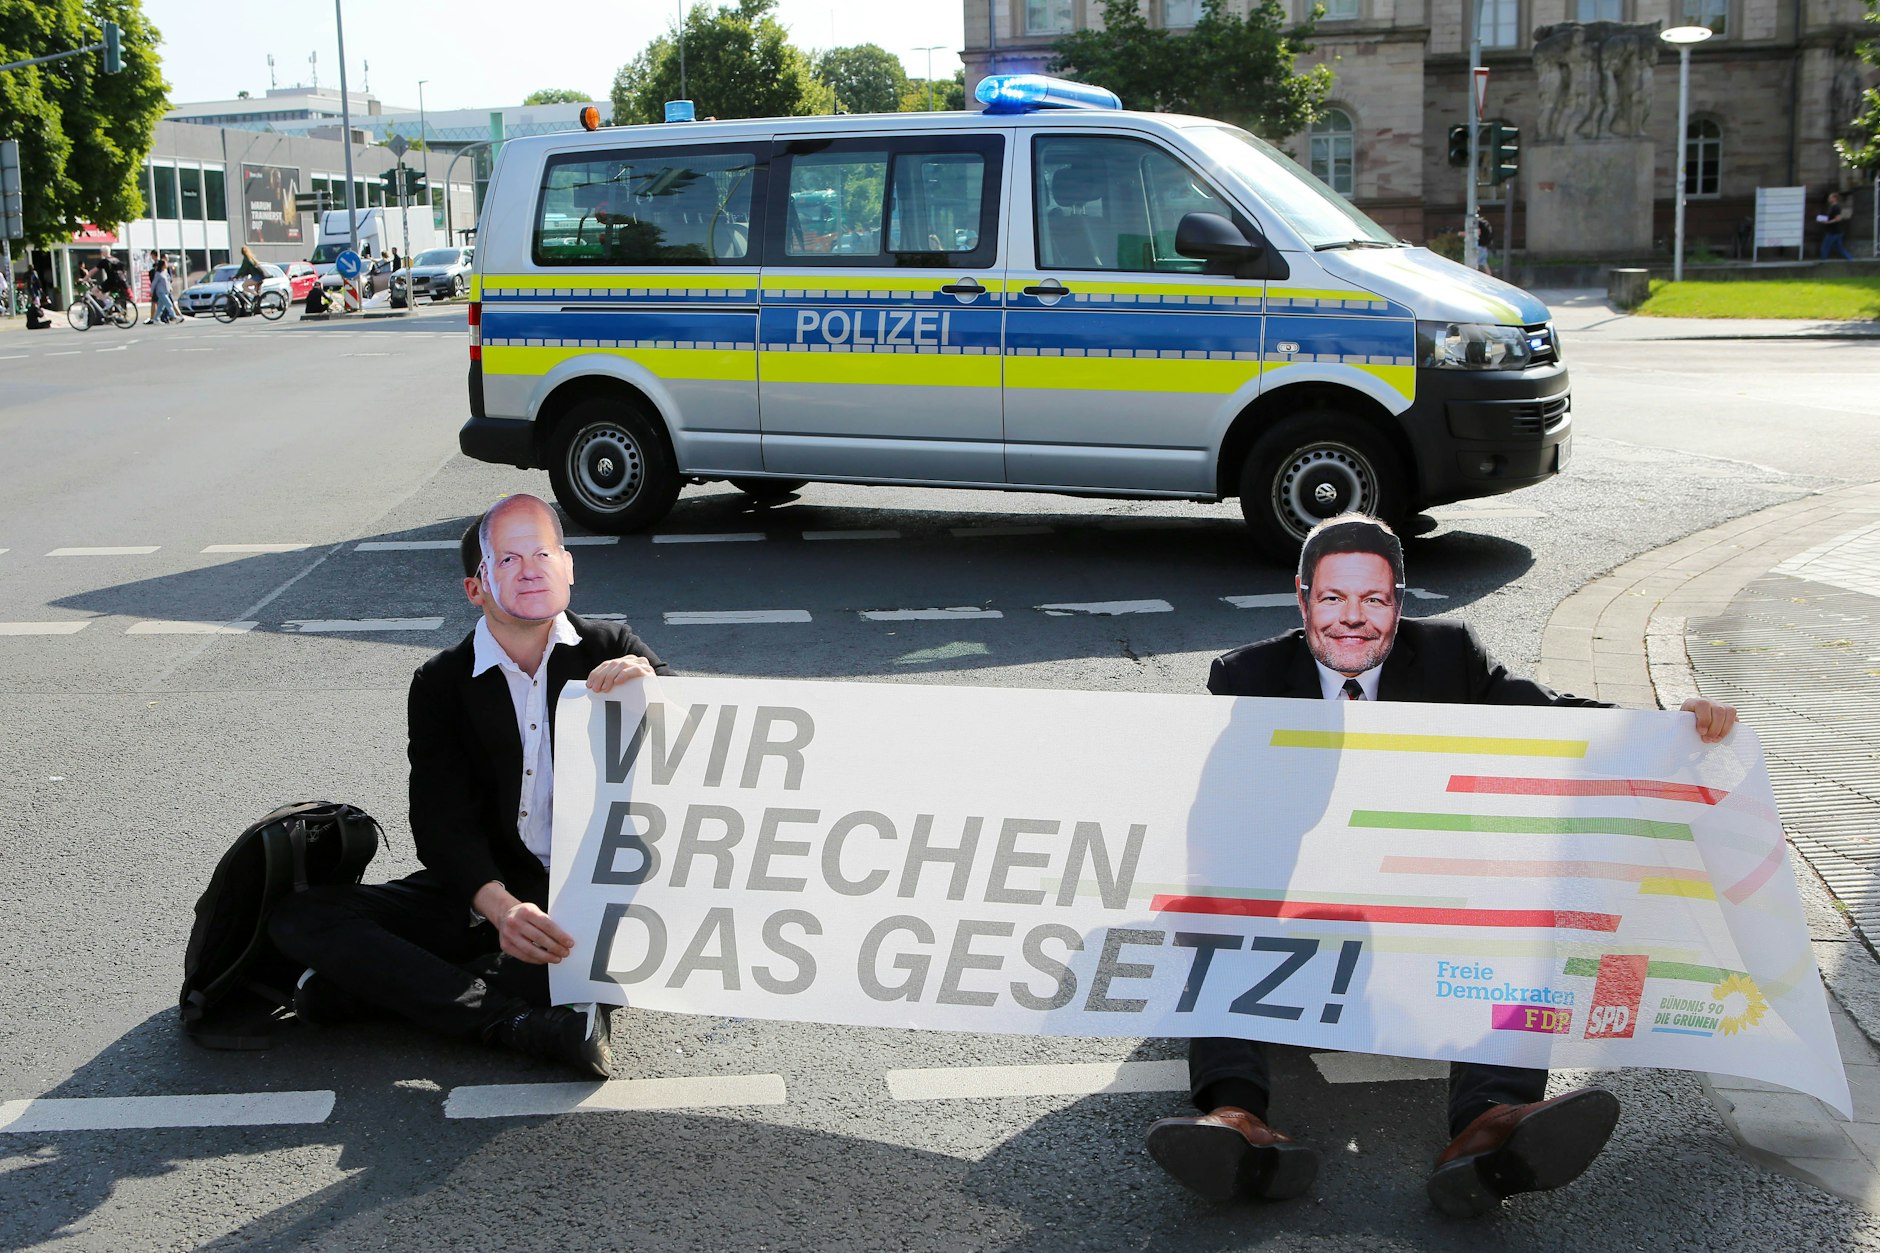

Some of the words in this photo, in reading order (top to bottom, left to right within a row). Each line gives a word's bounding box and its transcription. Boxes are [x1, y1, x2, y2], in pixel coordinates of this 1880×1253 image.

[796, 310, 950, 346] POLIZEI
[604, 700, 815, 791] WIR
[591, 801, 1147, 910] BRECHEN
[589, 903, 823, 995] DAS
[857, 915, 1363, 1024] GESETZ!
[1437, 961, 1494, 980] Freie
[1436, 981, 1575, 1005] Demokraten
[1660, 995, 1706, 1012] BÜNDNIS
[1708, 1003, 1724, 1015] 90
[1525, 1009, 1570, 1031] FDP
[1588, 1006, 1630, 1034] SPD
[1654, 1012, 1671, 1025] DIE
[1673, 1012, 1719, 1030] GRÜNEN
